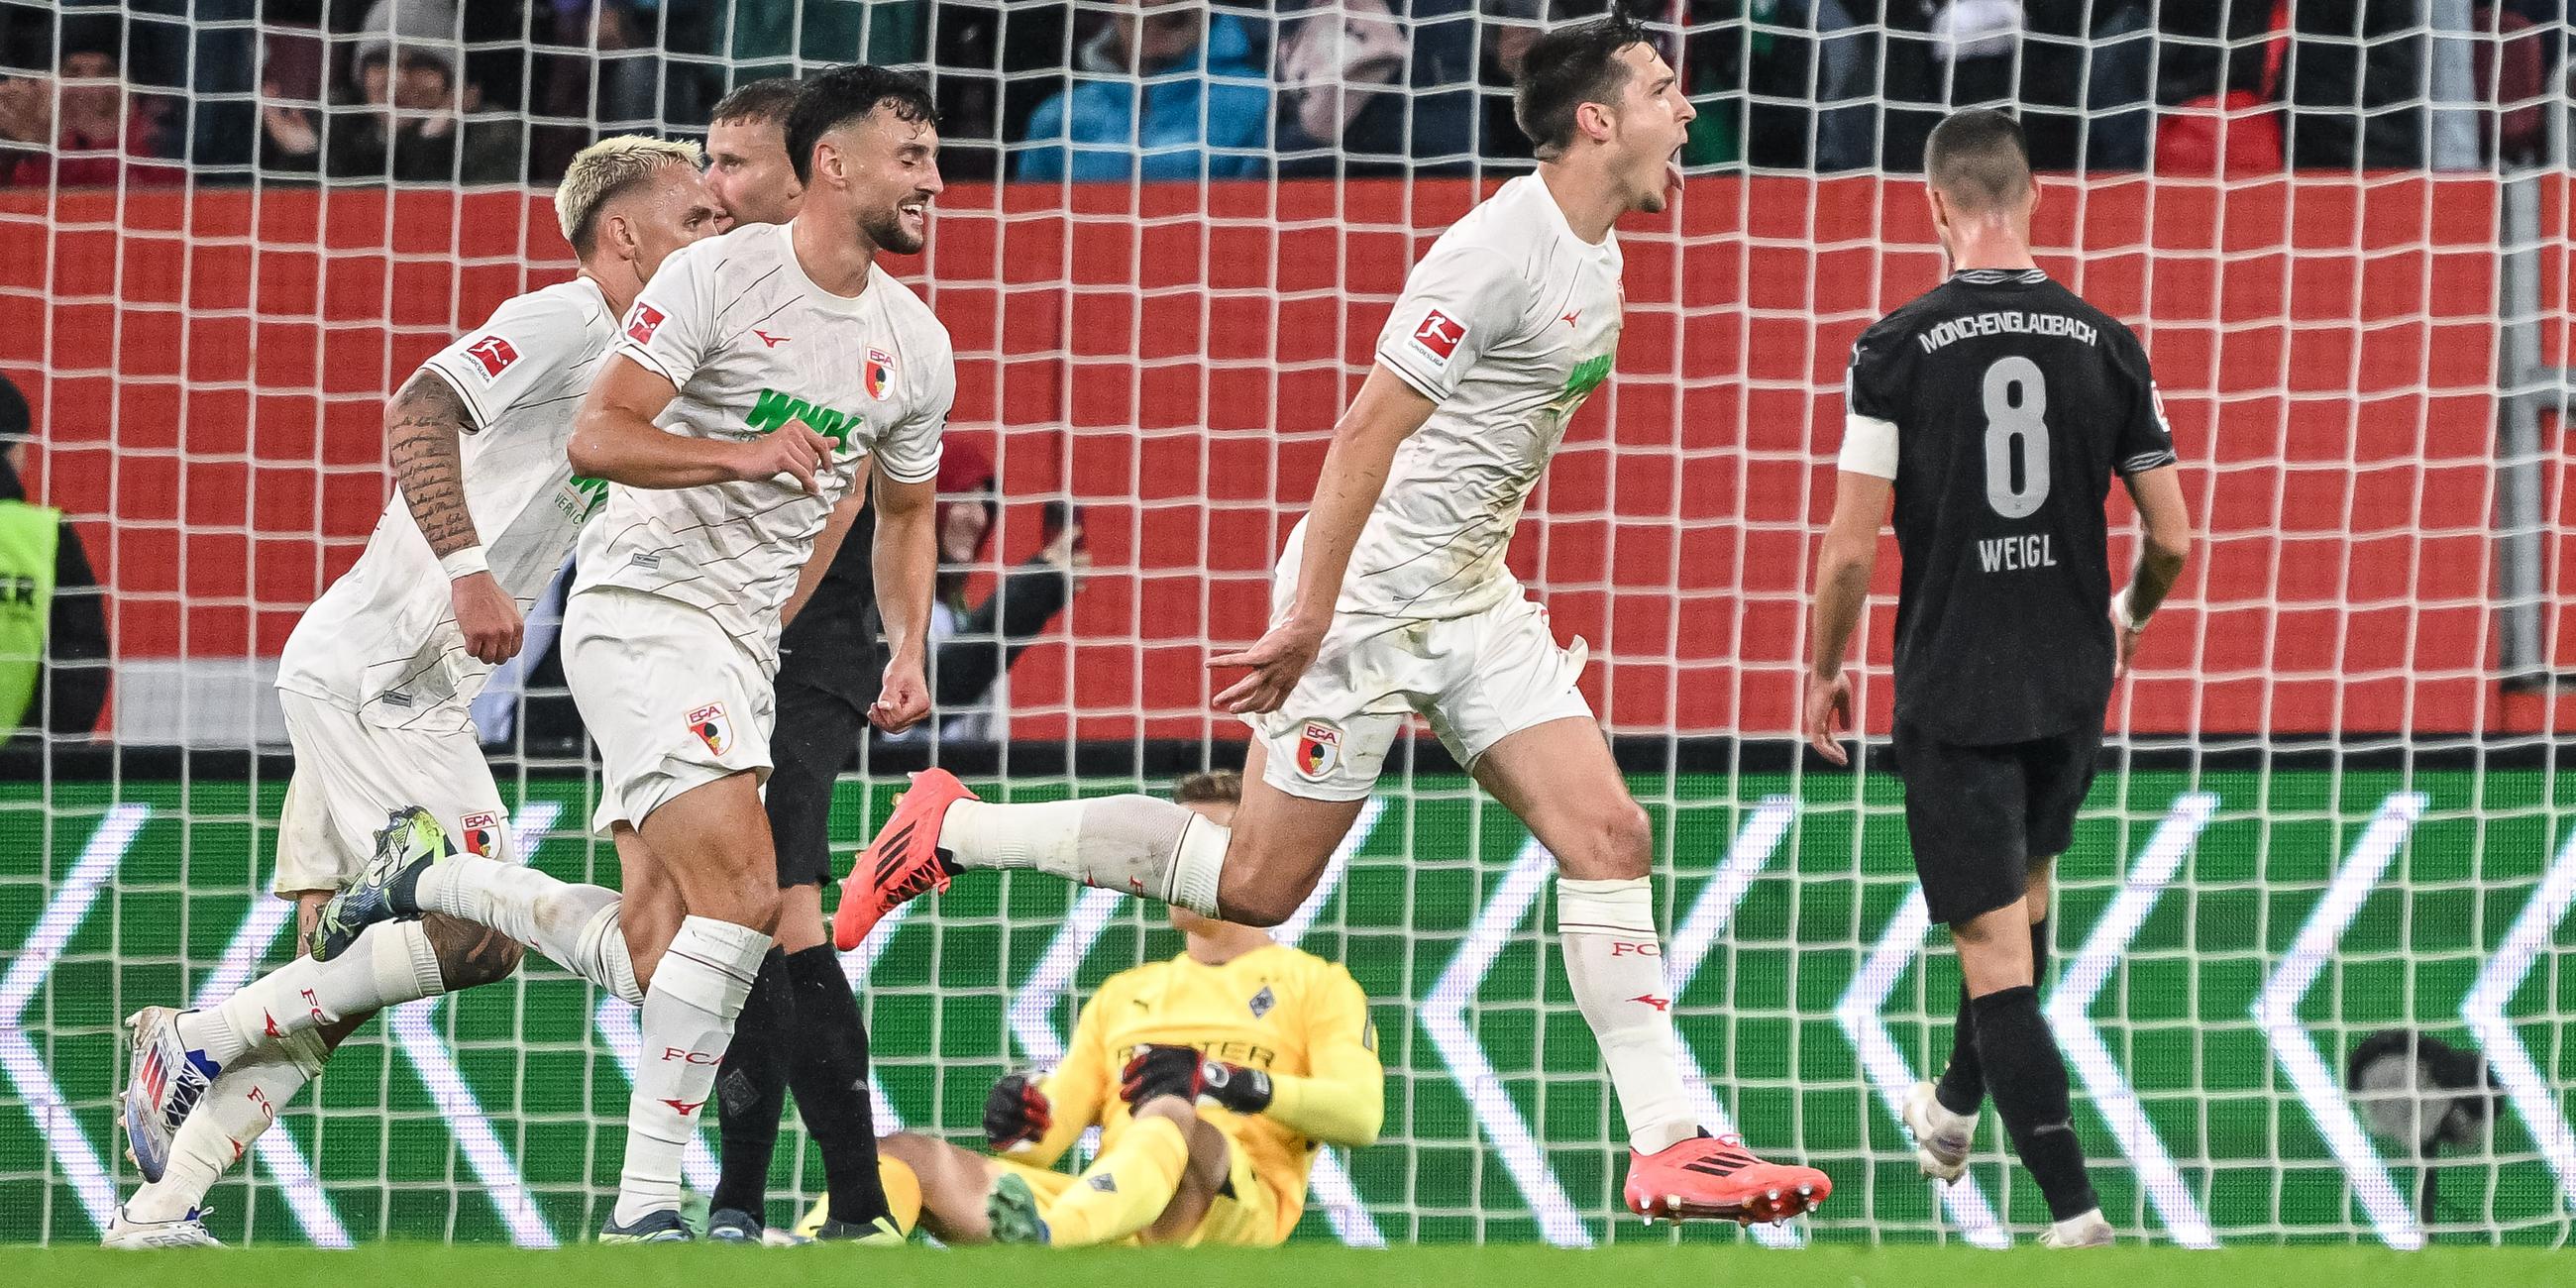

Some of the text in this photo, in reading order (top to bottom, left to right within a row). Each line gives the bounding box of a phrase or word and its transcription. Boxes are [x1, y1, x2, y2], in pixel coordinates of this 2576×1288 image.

[1918, 311, 2097, 355] MÖNCHENGLADBACH
[1983, 356, 2051, 520] 8
[1979, 534, 2058, 574] WEIGL
[1117, 1040, 1275, 1068] RTER
